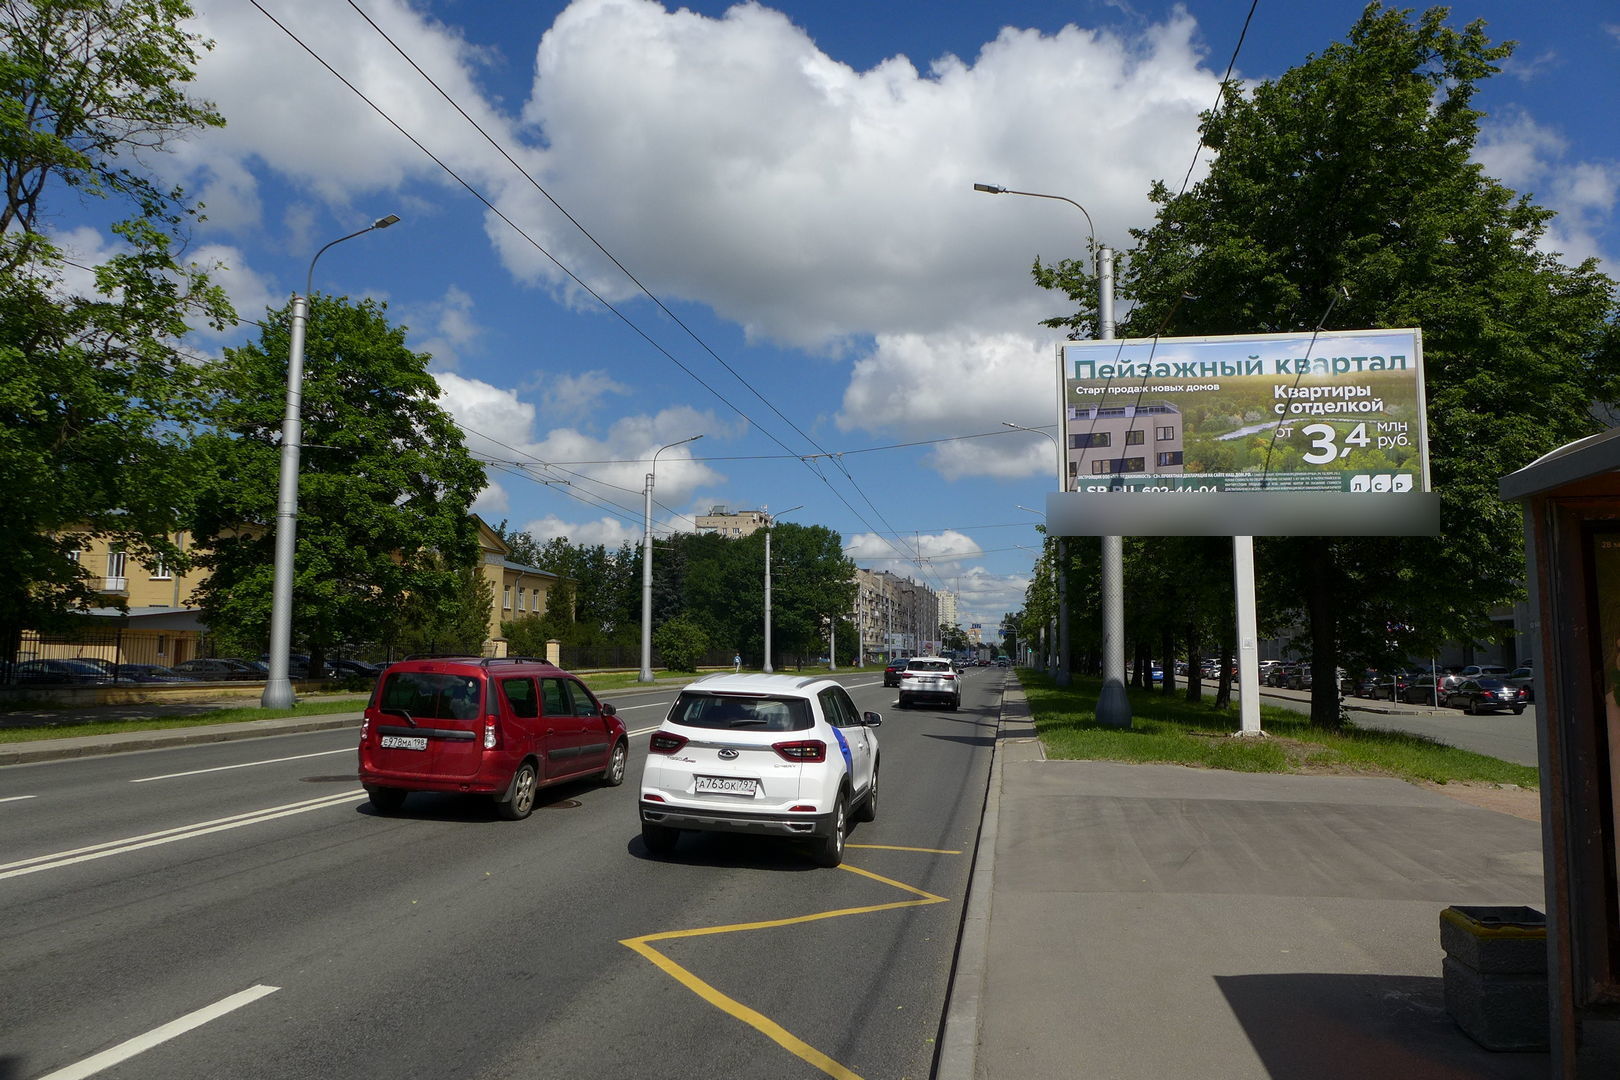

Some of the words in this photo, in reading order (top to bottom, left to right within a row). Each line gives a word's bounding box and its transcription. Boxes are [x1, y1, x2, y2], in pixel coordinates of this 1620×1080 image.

[1074, 354, 1263, 380] Пейзажный
[1275, 355, 1406, 376] квартал
[1076, 386, 1106, 395] Старт
[1108, 386, 1149, 394] продаж
[1186, 384, 1220, 392] домов
[1274, 385, 1371, 401] Квартиры
[1274, 403, 1285, 414] с
[1290, 398, 1384, 415] отделкой
[1377, 422, 1408, 432] млн
[1275, 427, 1294, 438] от
[1302, 422, 1371, 465] 3,4
[1377, 433, 1411, 449] руб.
